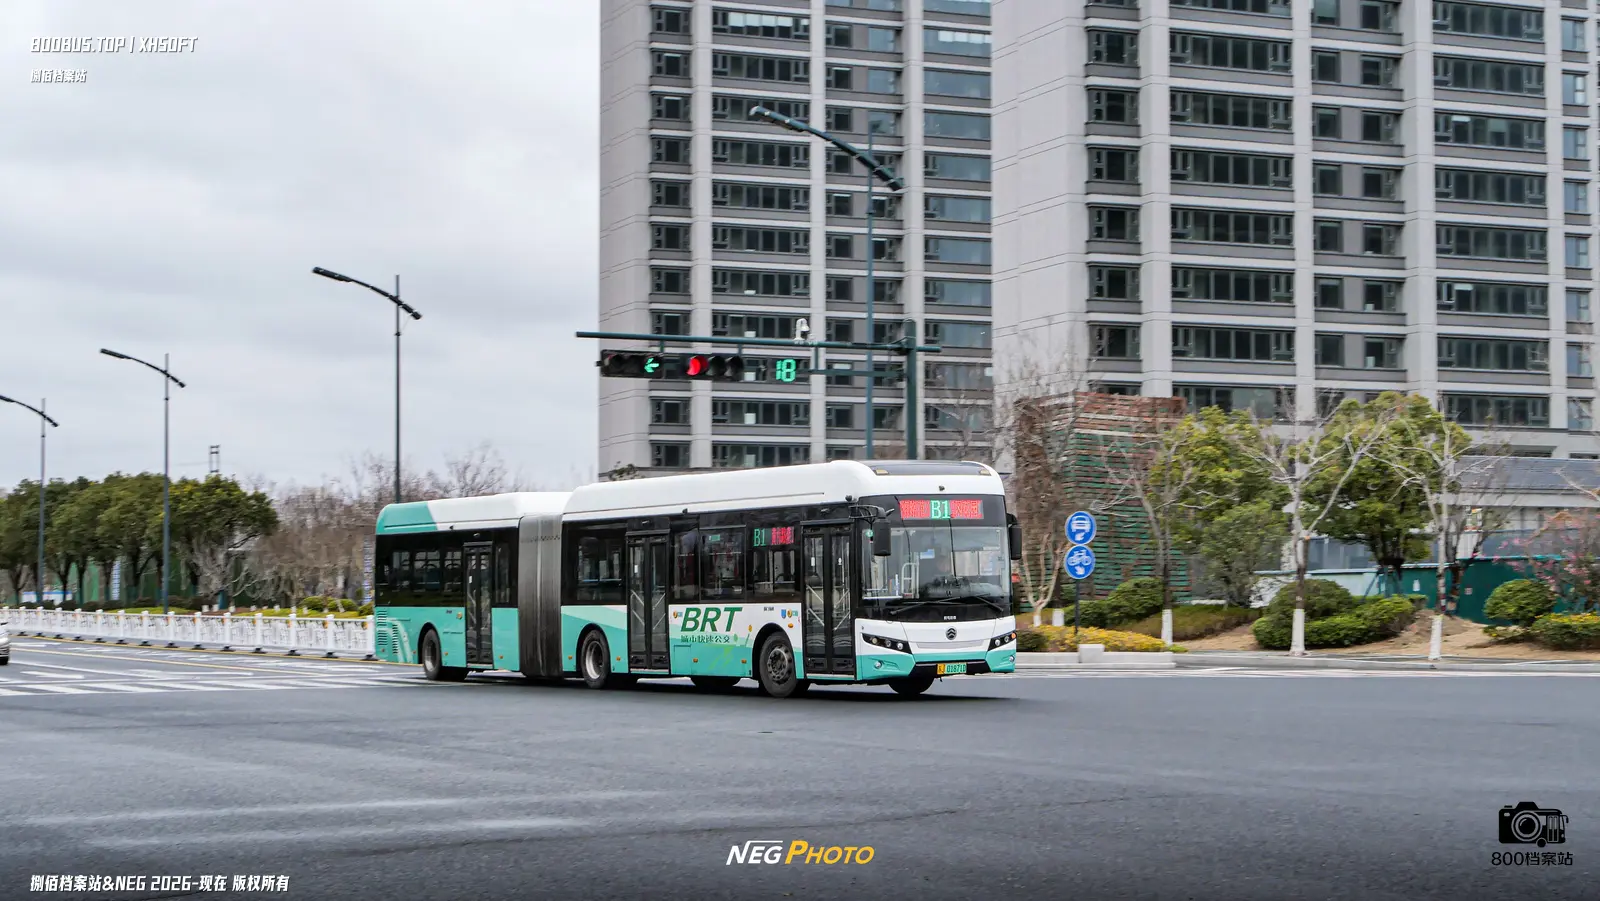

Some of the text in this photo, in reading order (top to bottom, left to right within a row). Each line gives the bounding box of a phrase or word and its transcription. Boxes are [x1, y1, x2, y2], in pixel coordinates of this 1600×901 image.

[775, 358, 796, 382] 18
[930, 500, 951, 519] B1
[753, 528, 767, 547] B1
[680, 606, 743, 632] BRT
